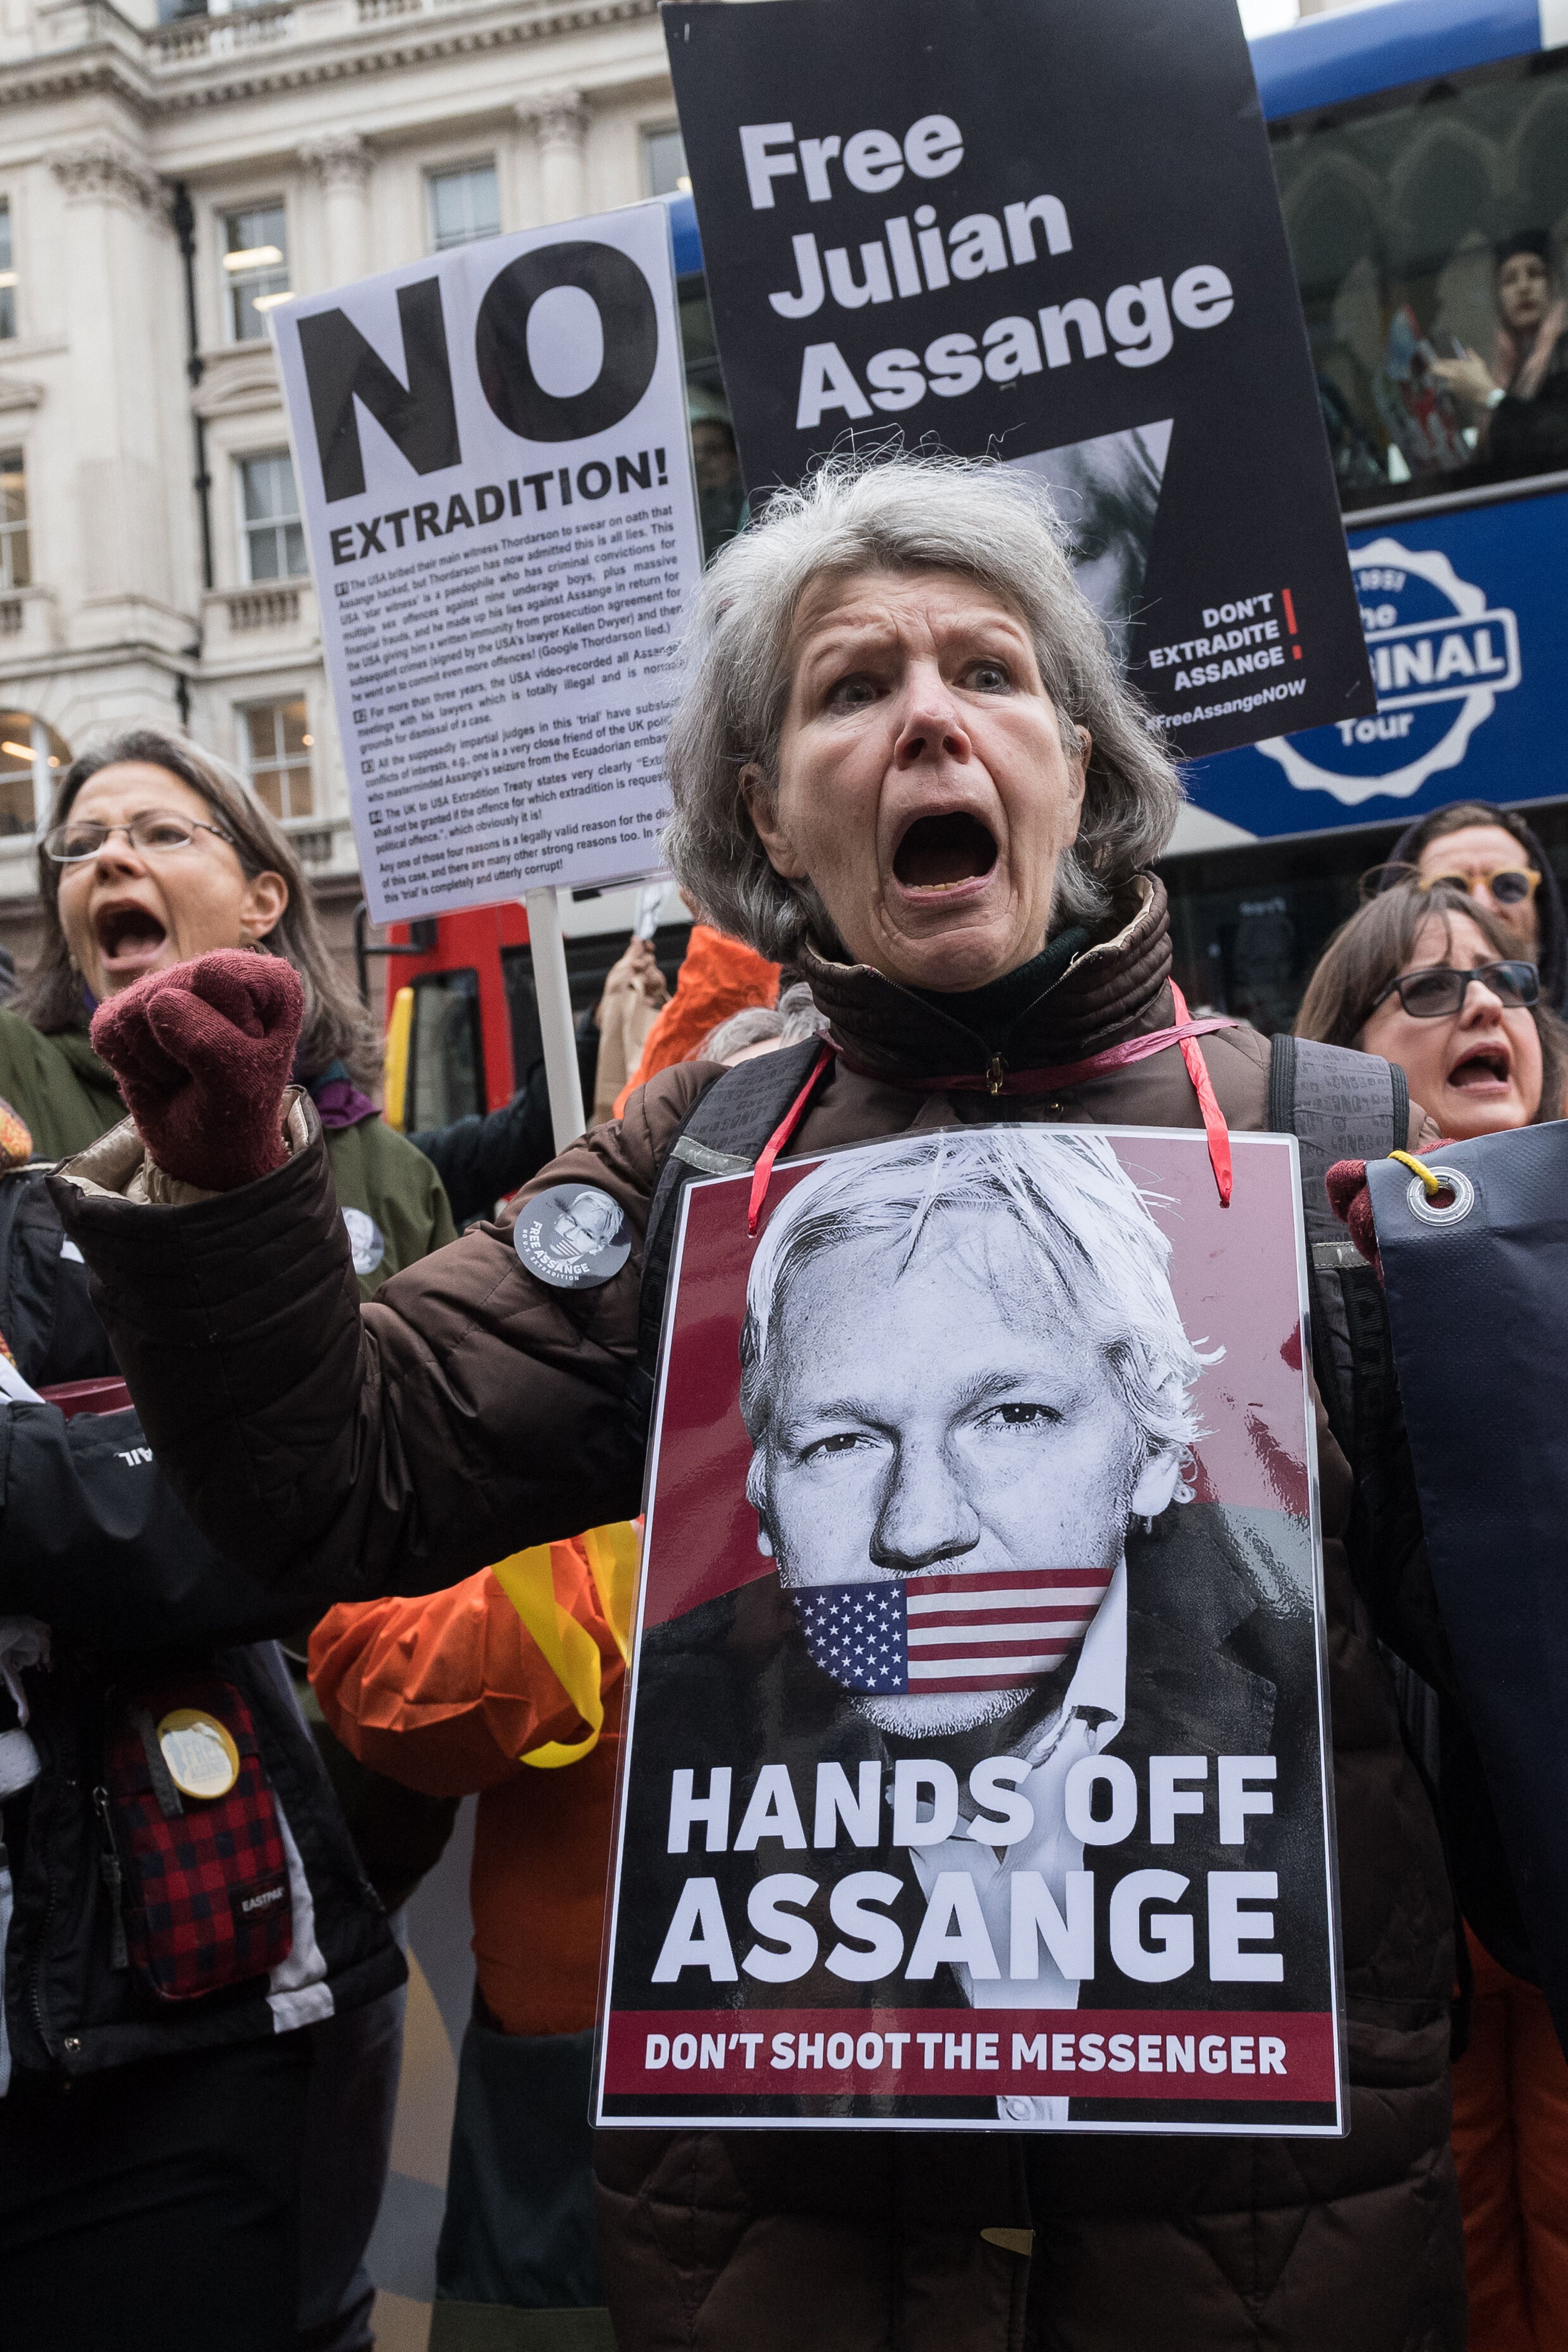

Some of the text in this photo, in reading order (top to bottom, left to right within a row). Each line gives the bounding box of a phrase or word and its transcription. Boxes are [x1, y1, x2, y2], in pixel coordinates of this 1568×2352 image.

[740, 115, 963, 209] Free
[769, 195, 1072, 318] Julian
[796, 265, 1233, 429] Assange
[296, 241, 659, 504] NO
[329, 447, 668, 566] EXTRADITION!
[561, 527, 572, 537] to
[574, 519, 605, 534] swear
[608, 516, 622, 527] on
[625, 509, 649, 523] oath
[651, 505, 672, 518] that
[503, 554, 524, 565] now
[527, 541, 571, 561] admitted
[574, 539, 594, 551] this
[597, 535, 607, 546] is
[610, 531, 622, 543] all
[650, 521, 674, 534] This
[524, 566, 543, 578] has
[547, 554, 589, 573] criminal
[594, 543, 656, 563] convictions
[660, 538, 676, 549] for
[603, 565, 626, 580] plus
[633, 555, 677, 572] massive
[516, 616, 540, 629] from
[542, 604, 604, 626] prosecution
[608, 590, 663, 612] agreement
[666, 587, 681, 598] for
[527, 594, 564, 612] against
[567, 585, 612, 602] Assange
[615, 582, 625, 592] in
[629, 576, 661, 589] return
[664, 571, 679, 582] for
[1202, 592, 1274, 629] DON'T
[561, 622, 595, 636] Kellen
[637, 607, 657, 621] and
[538, 641, 578, 659] (Google
[581, 630, 642, 648] Thordarson
[1149, 619, 1281, 669] EXTRADITE
[1369, 629, 1506, 691] INAL
[509, 670, 531, 684] USA
[534, 654, 612, 679] video-recorded
[617, 651, 629, 664] all
[511, 690, 520, 700] is
[526, 683, 558, 697] totally
[564, 674, 595, 690] illegal
[602, 670, 621, 683] and
[627, 668, 637, 677] is
[1174, 646, 1285, 691] ASSANGE
[502, 725, 535, 742] judges
[539, 722, 549, 732] in
[552, 717, 572, 730] this
[605, 707, 631, 720] have
[510, 743, 531, 754] very
[533, 737, 560, 750] close
[562, 729, 593, 744] friend
[595, 726, 606, 738] of
[608, 724, 625, 736] the
[628, 719, 644, 732] UK
[1336, 712, 1413, 746] Tour
[527, 755, 551, 767] from
[553, 751, 570, 762] the
[571, 740, 631, 759] Ecuadorian
[503, 779, 532, 792] Treaty
[537, 773, 567, 786] states
[571, 769, 593, 780] very
[598, 760, 632, 775] clearly
[511, 796, 524, 807] for
[527, 790, 557, 804] which
[559, 782, 614, 799] extradition
[616, 778, 625, 789] is
[541, 843, 574, 856] strong
[576, 835, 617, 849] reasons
[619, 832, 640, 842] too.
[642, 828, 653, 838] In
[554, 823, 579, 836] valid
[581, 819, 616, 833] reason
[618, 815, 633, 826] for
[635, 812, 652, 823] the
[529, 1220, 590, 1275] FREE ASSANGE
[530, 1257, 579, 1281] EXTRADITION
[667, 1754, 1277, 1854] HANDS OFF
[651, 1868, 1284, 1983] ASSANGE
[645, 2032, 1288, 2075] DON'T SHOOT THE MESSENGER
